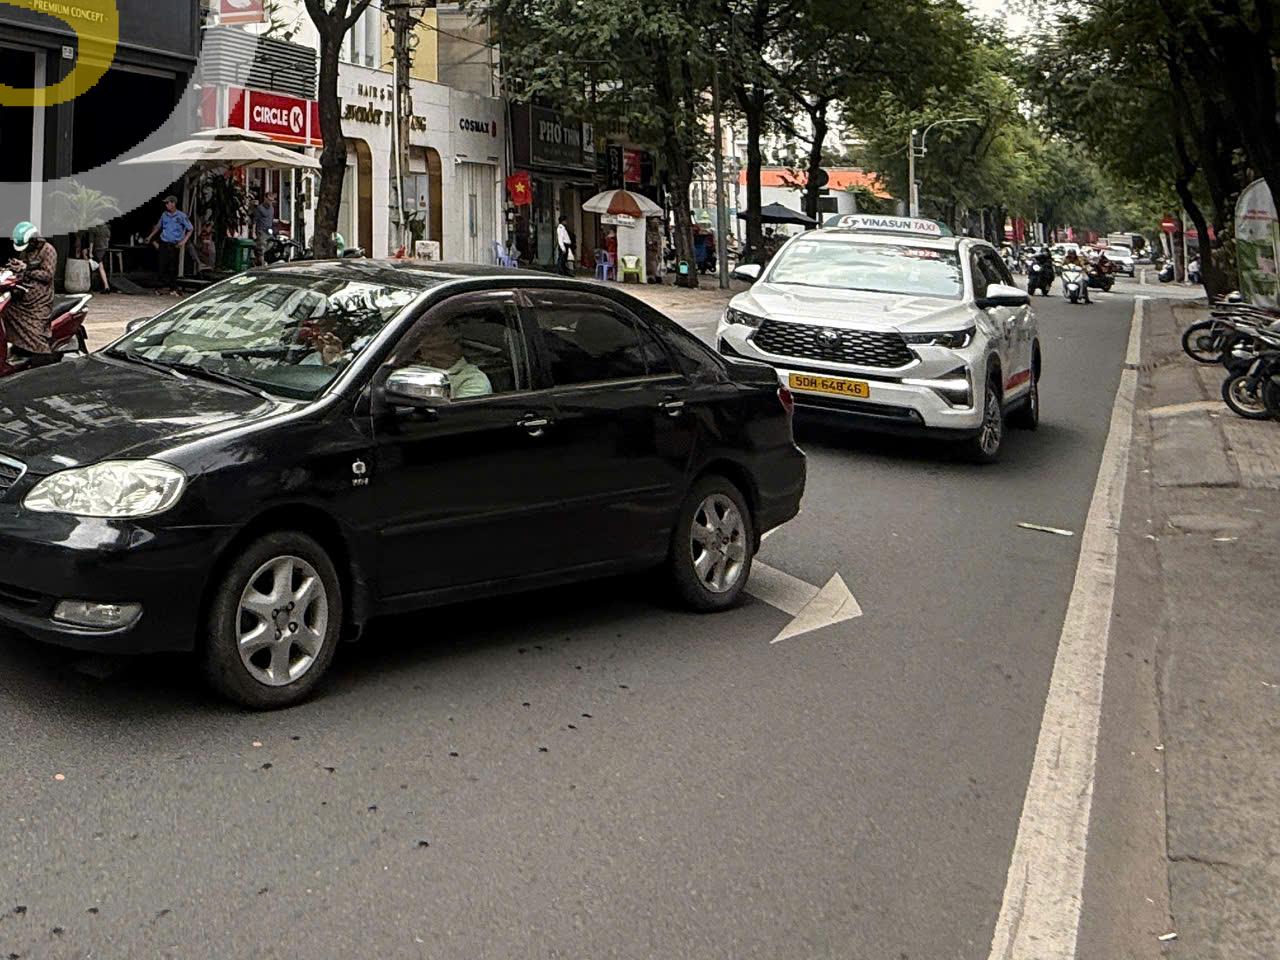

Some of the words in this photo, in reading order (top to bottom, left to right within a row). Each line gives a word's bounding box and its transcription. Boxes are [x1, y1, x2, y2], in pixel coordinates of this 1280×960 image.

[70, 6, 105, 23] CONCEPT
[357, 83, 378, 99] HAIR
[252, 105, 288, 127] CIRCLE
[861, 218, 911, 230] VINASUN
[914, 220, 936, 231] TAXI
